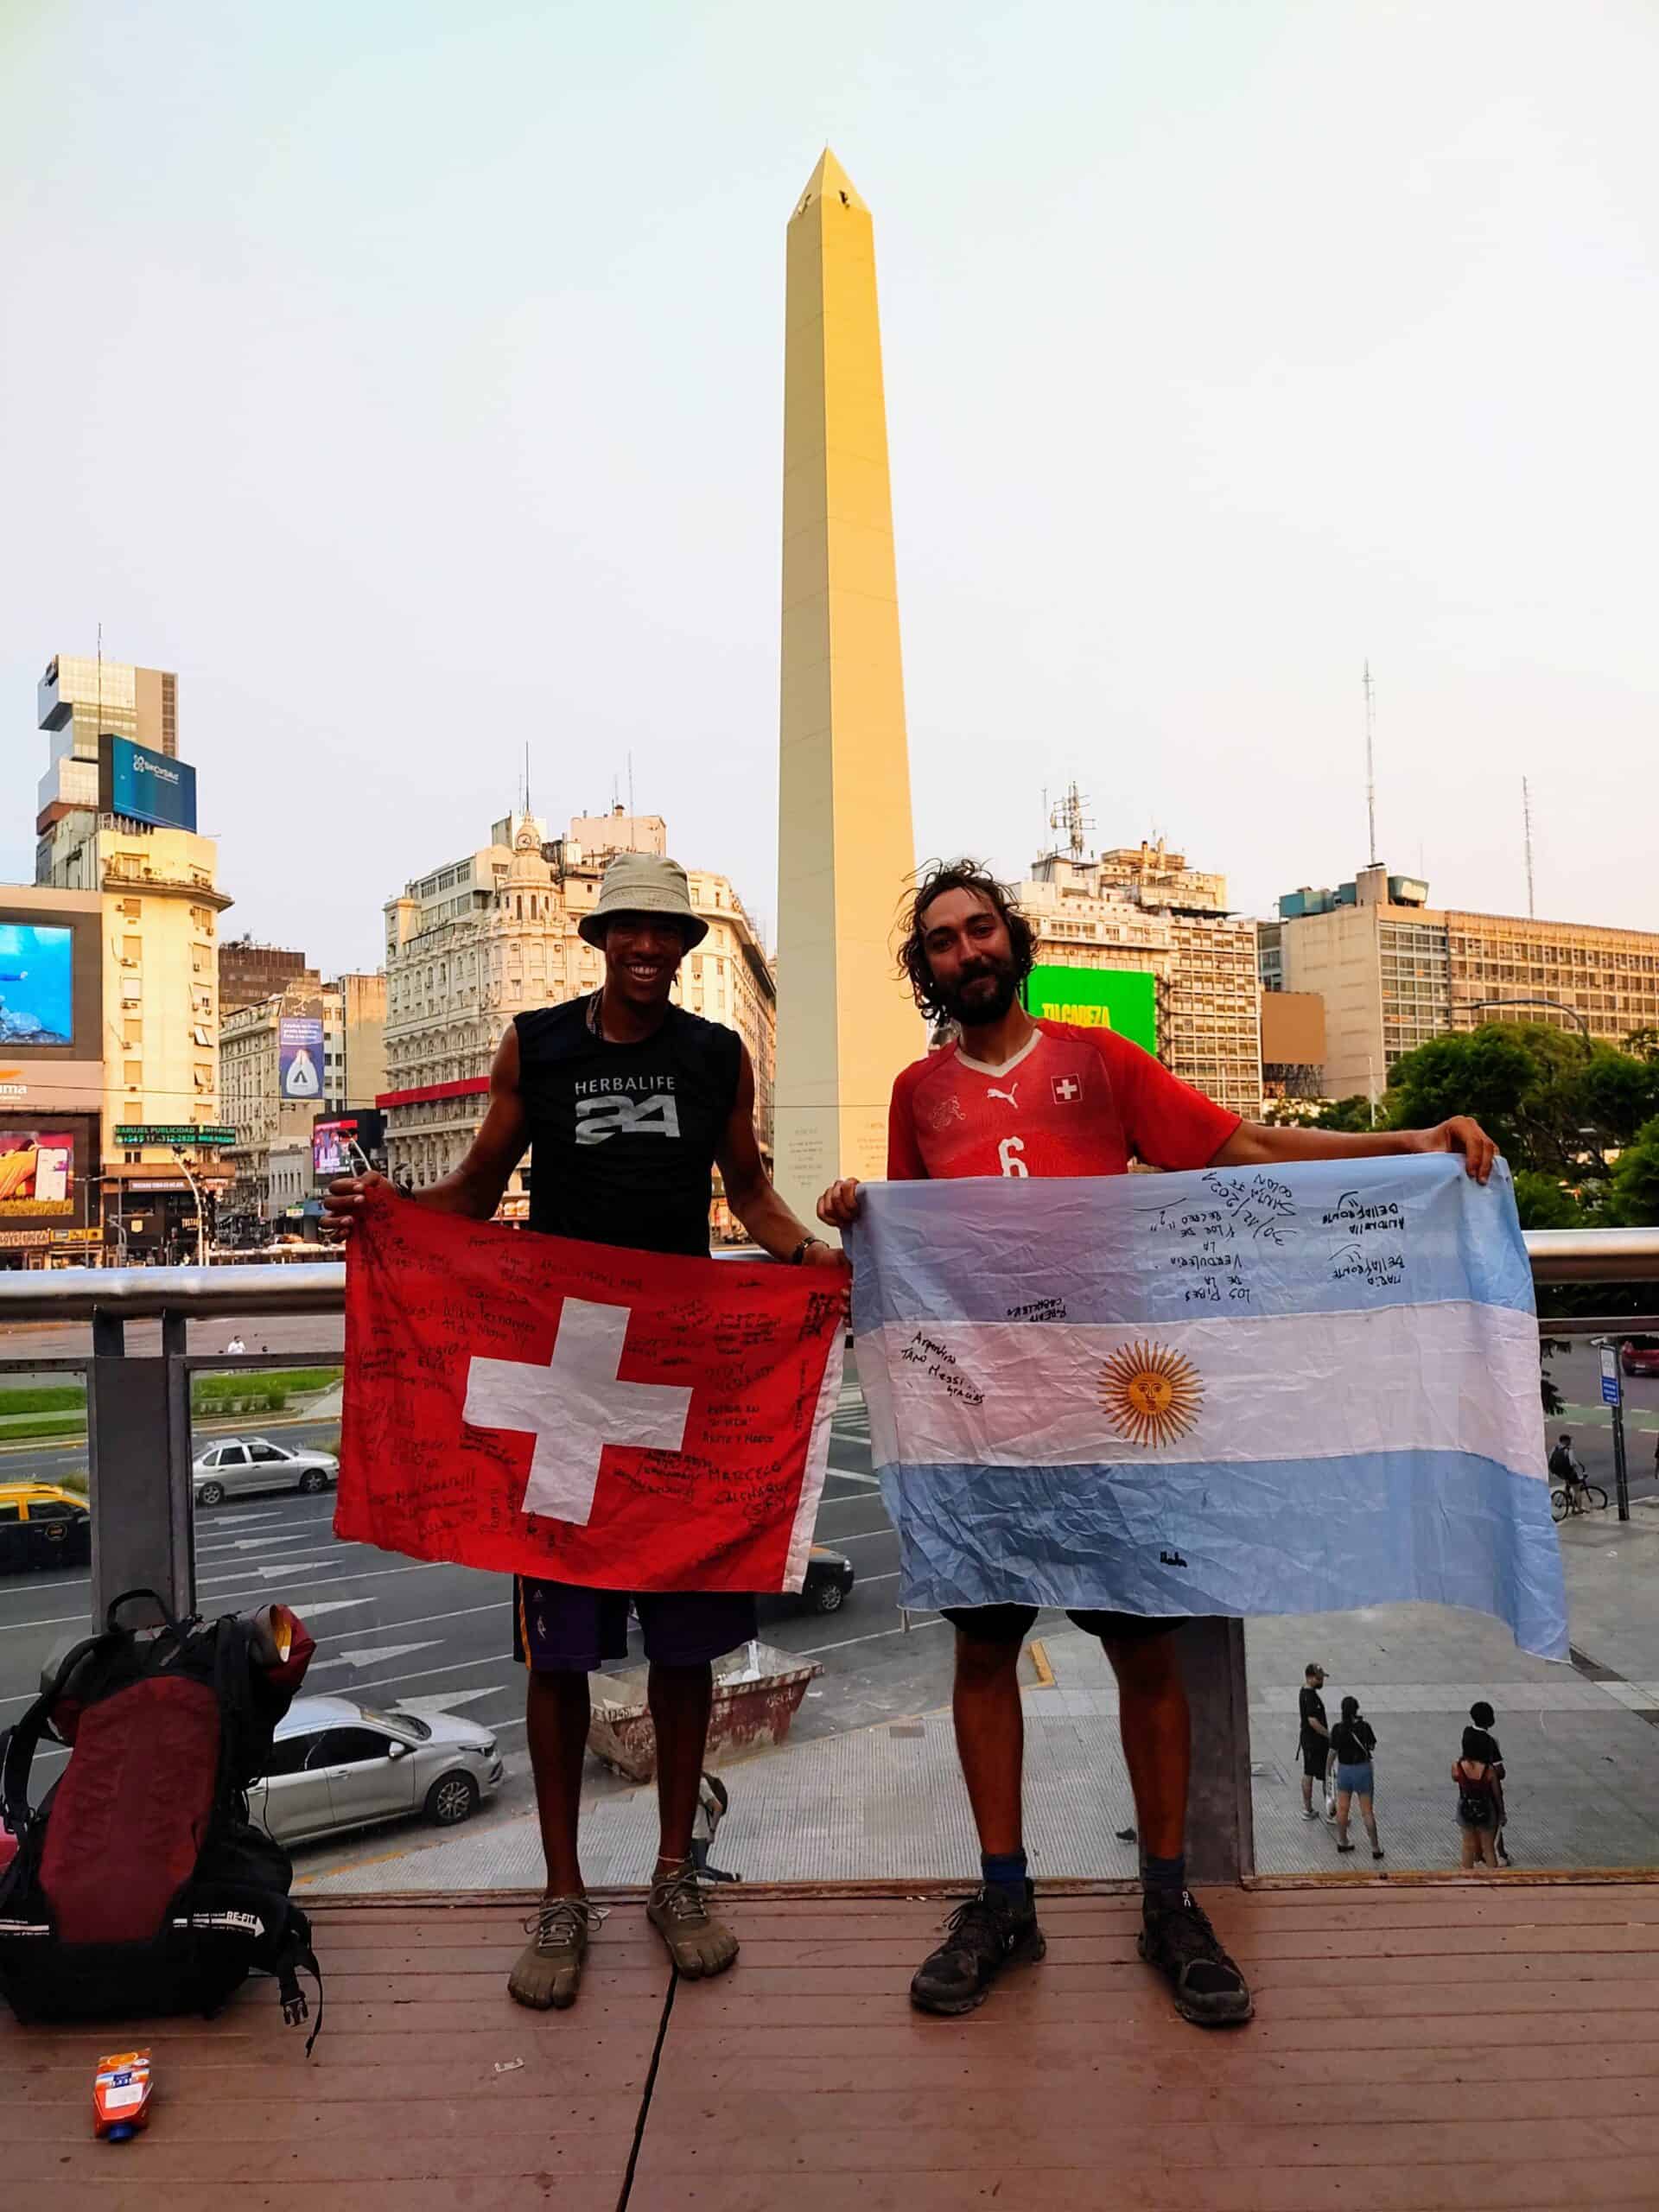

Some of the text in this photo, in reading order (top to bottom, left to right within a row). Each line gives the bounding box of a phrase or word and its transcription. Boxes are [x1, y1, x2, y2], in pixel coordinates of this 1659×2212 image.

[575, 1076, 676, 1096] HERBALIFE
[575, 1095, 681, 1145] 24
[998, 1136, 1029, 1178] 6
[1203, 1241, 1216, 1254] LA
[1229, 1287, 1250, 1303] LOS
